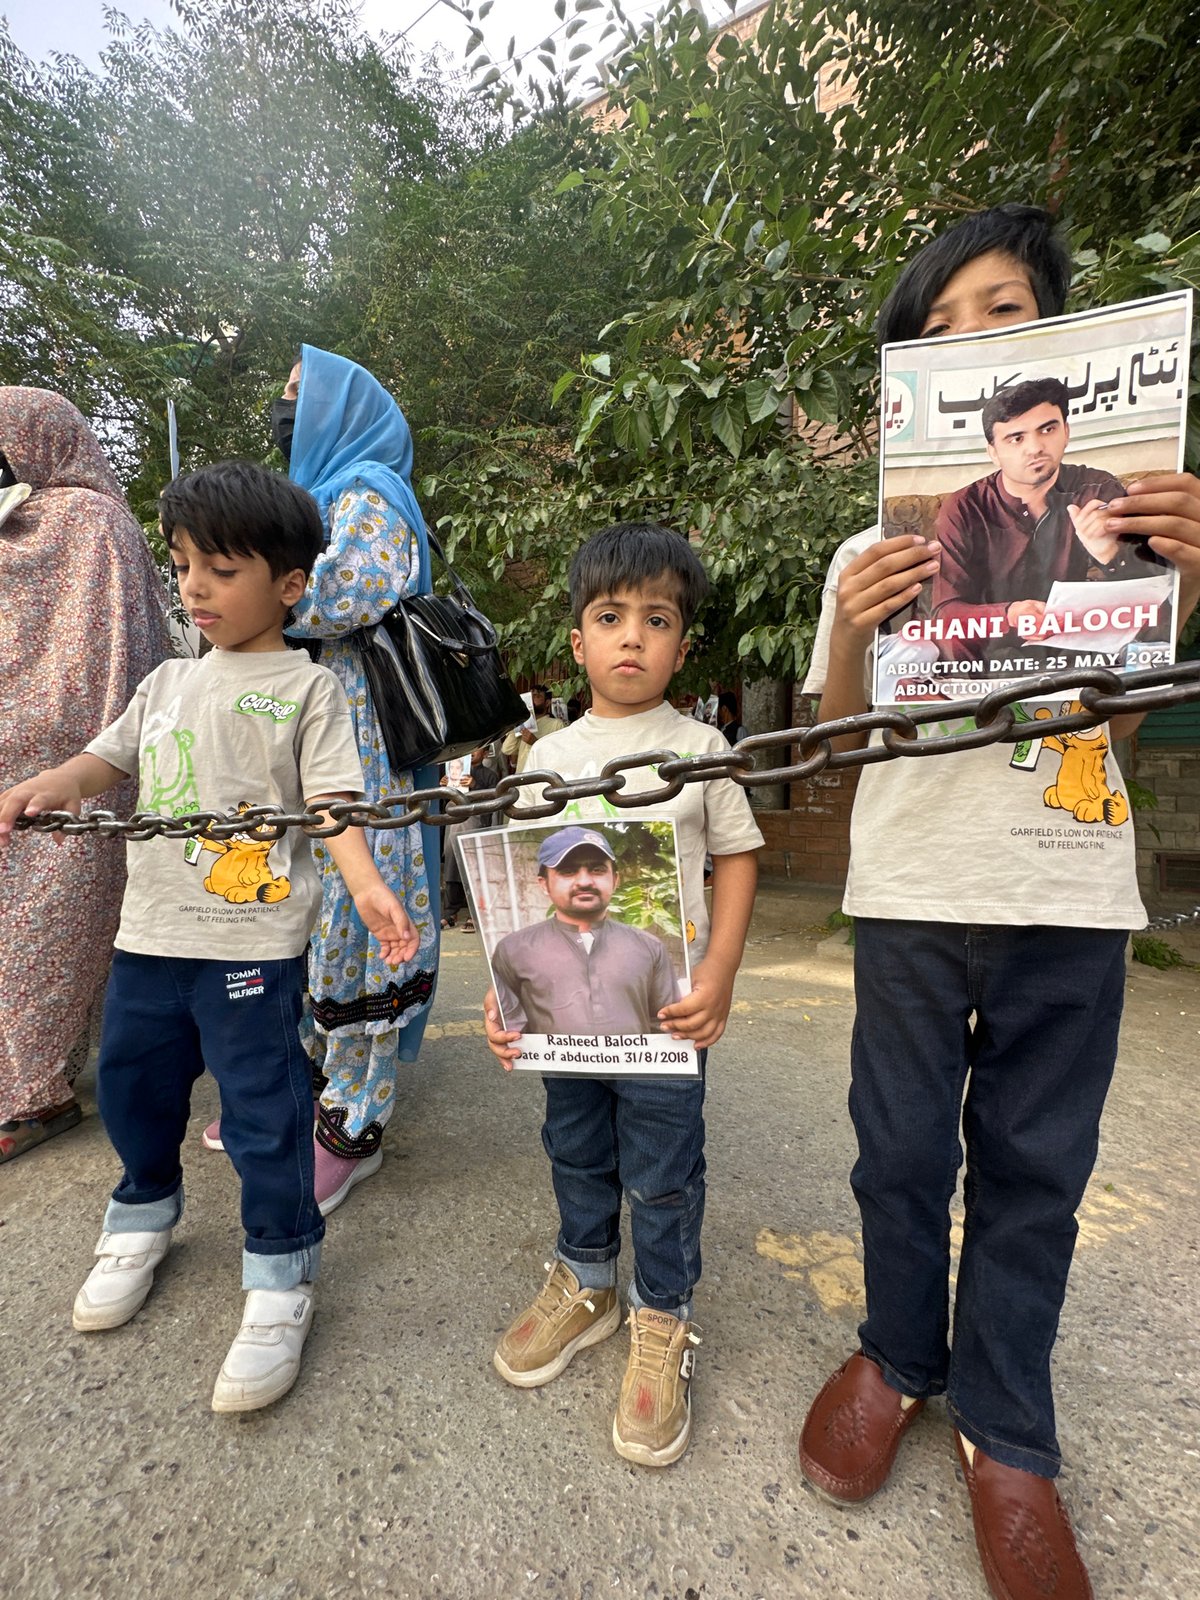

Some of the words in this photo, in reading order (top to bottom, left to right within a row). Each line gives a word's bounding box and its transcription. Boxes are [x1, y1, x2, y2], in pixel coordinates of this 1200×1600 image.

[1128, 342, 1183, 405] ئٹہ
[902, 616, 1004, 641] GHANI
[1017, 604, 1160, 636] BALOCH
[886, 659, 983, 676] ABDUCTION
[989, 656, 1040, 672] DATE:
[1046, 655, 1068, 670] 25
[1075, 652, 1119, 668] MAY
[1126, 650, 1172, 665] 2025
[894, 682, 993, 697] ABDUCTION
[1010, 828, 1054, 837] GARFIELD
[1055, 828, 1062, 837] IS
[1063, 829, 1081, 838] LOW
[1082, 829, 1094, 838] ON
[1096, 830, 1123, 839] PATIENCE
[1038, 840, 1056, 849] BUT
[1057, 841, 1088, 849] FEELING
[178, 905, 211, 913] GARFIELD
[247, 905, 280, 914] PATIENCE
[225, 967, 261, 982] TOMMY
[228, 985, 265, 1000] HILFIGER
[547, 1034, 599, 1047] Rasheed
[605, 1034, 648, 1047] Baloch
[544, 1051, 556, 1061] of
[561, 1051, 620, 1063] abduction
[625, 1051, 689, 1063] 31/8/2018
[647, 1313, 673, 1326] SPORT
